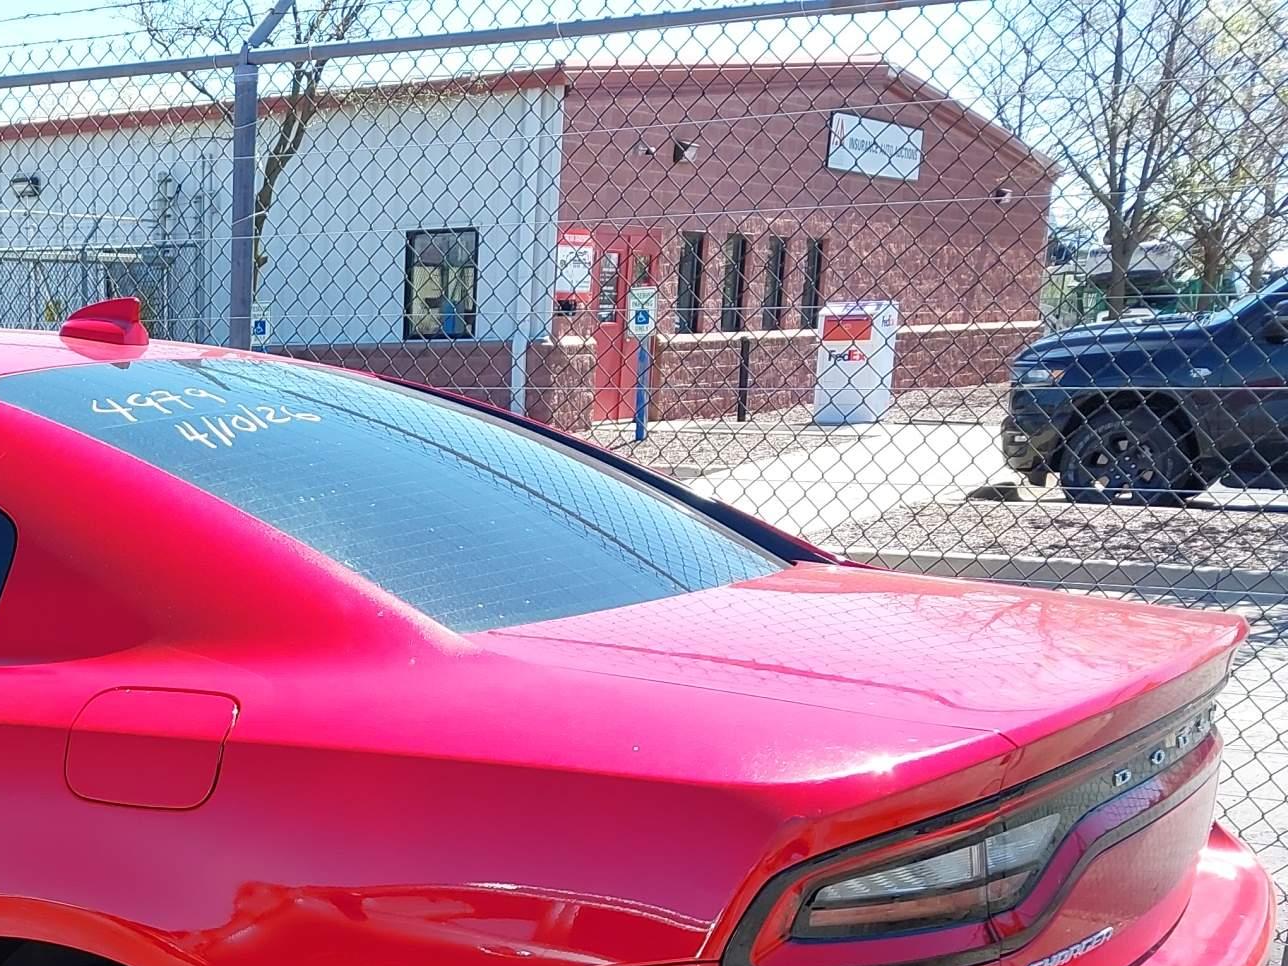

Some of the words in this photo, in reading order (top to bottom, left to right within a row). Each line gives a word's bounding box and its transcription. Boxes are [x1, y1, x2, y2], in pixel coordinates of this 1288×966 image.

[828, 349, 866, 362] FedEx
[92, 387, 226, 422] 4979
[174, 404, 324, 448] 4/10/26
[1112, 703, 1217, 788] DOD
